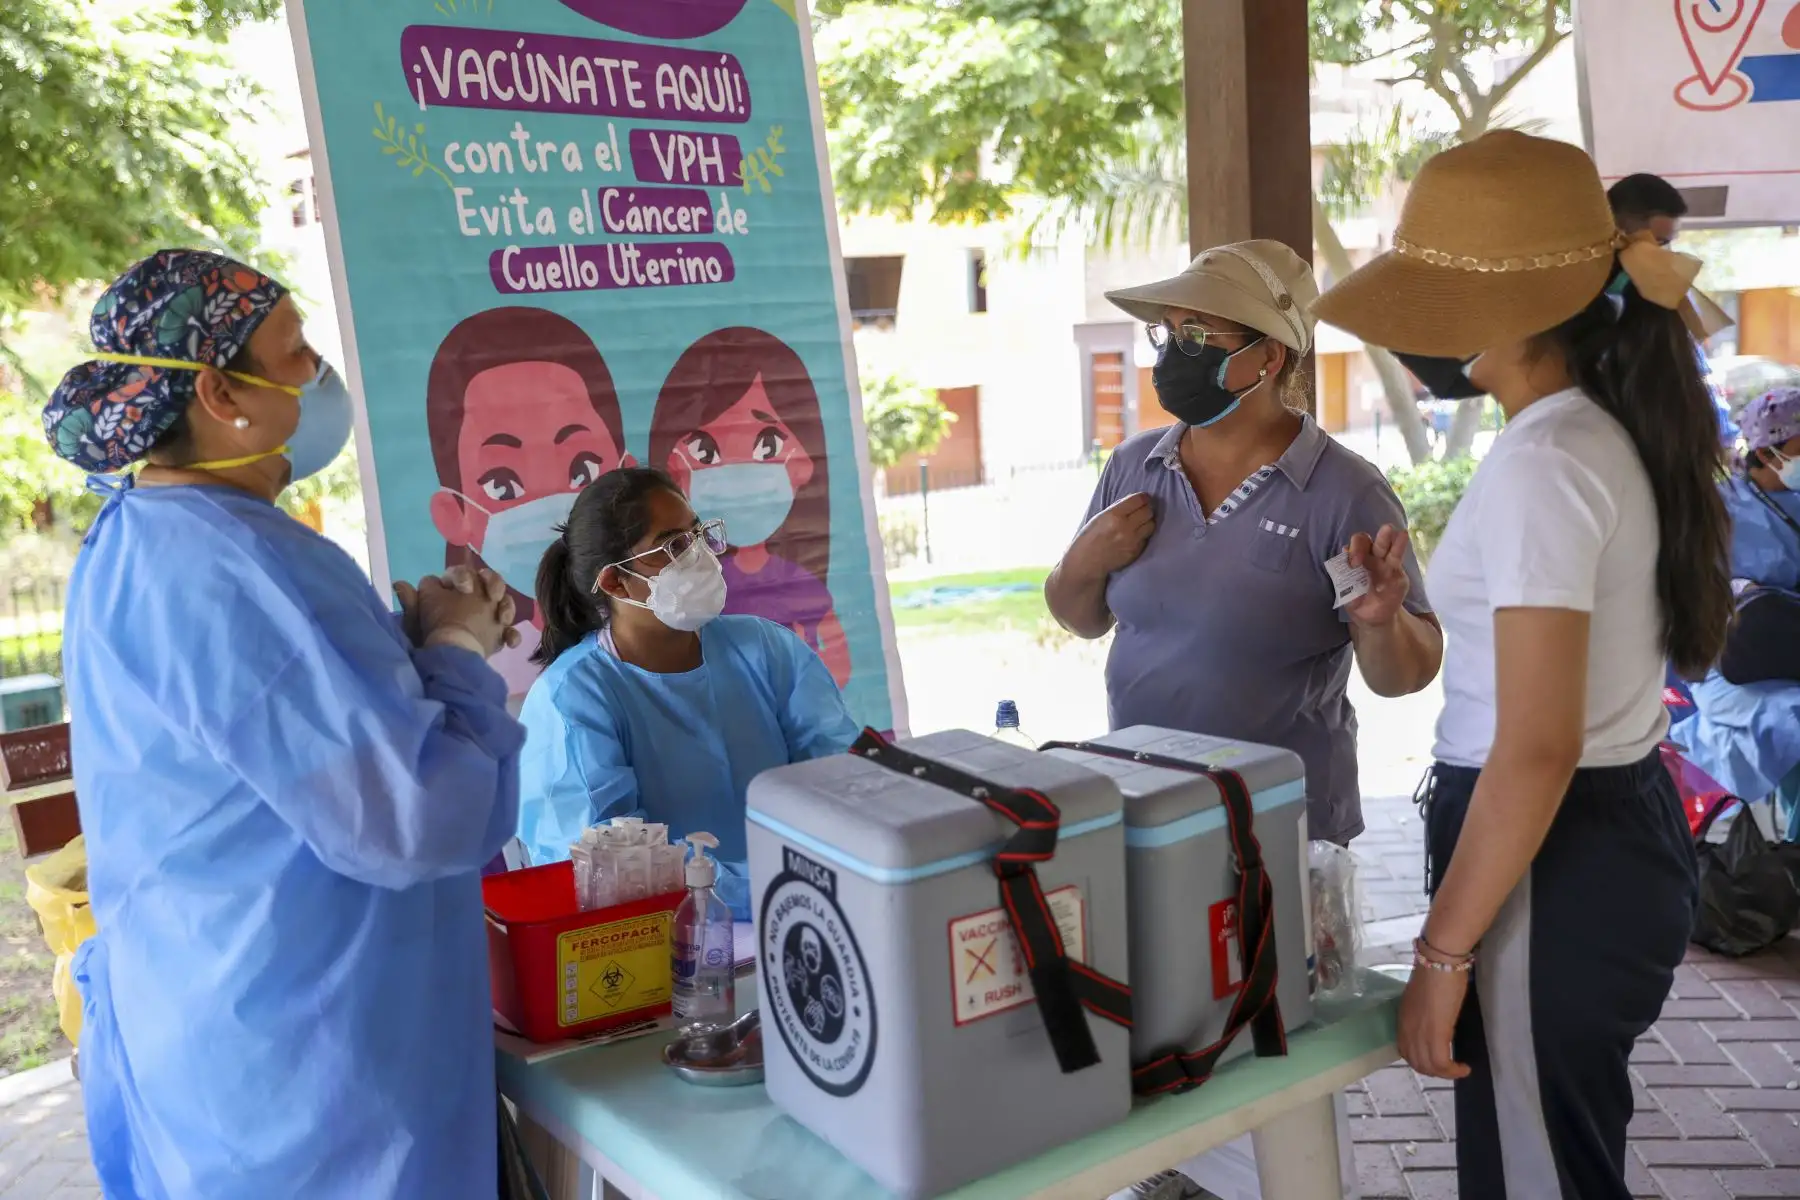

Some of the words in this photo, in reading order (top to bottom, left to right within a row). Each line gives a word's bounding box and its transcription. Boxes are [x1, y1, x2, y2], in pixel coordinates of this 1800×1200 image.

[413, 39, 646, 111] ¡VACÚNATE
[655, 53, 746, 114] AQUÍ!
[444, 122, 583, 174] contra
[595, 123, 621, 172] el
[649, 132, 725, 183] VPH
[454, 185, 556, 236] Evita
[568, 188, 594, 235] el
[602, 189, 708, 234] Cáncer
[716, 193, 749, 235] de
[502, 246, 600, 291] Cuello
[605, 242, 723, 286] Uterino
[788, 851, 833, 893] MINSA
[572, 925, 660, 951] FERCOPACK
[770, 920, 779, 945] NO
[814, 902, 825, 921] LA
[827, 919, 860, 997] GUARDIA
[959, 919, 1011, 942] VACCIN
[984, 983, 1022, 1004] RUSH
